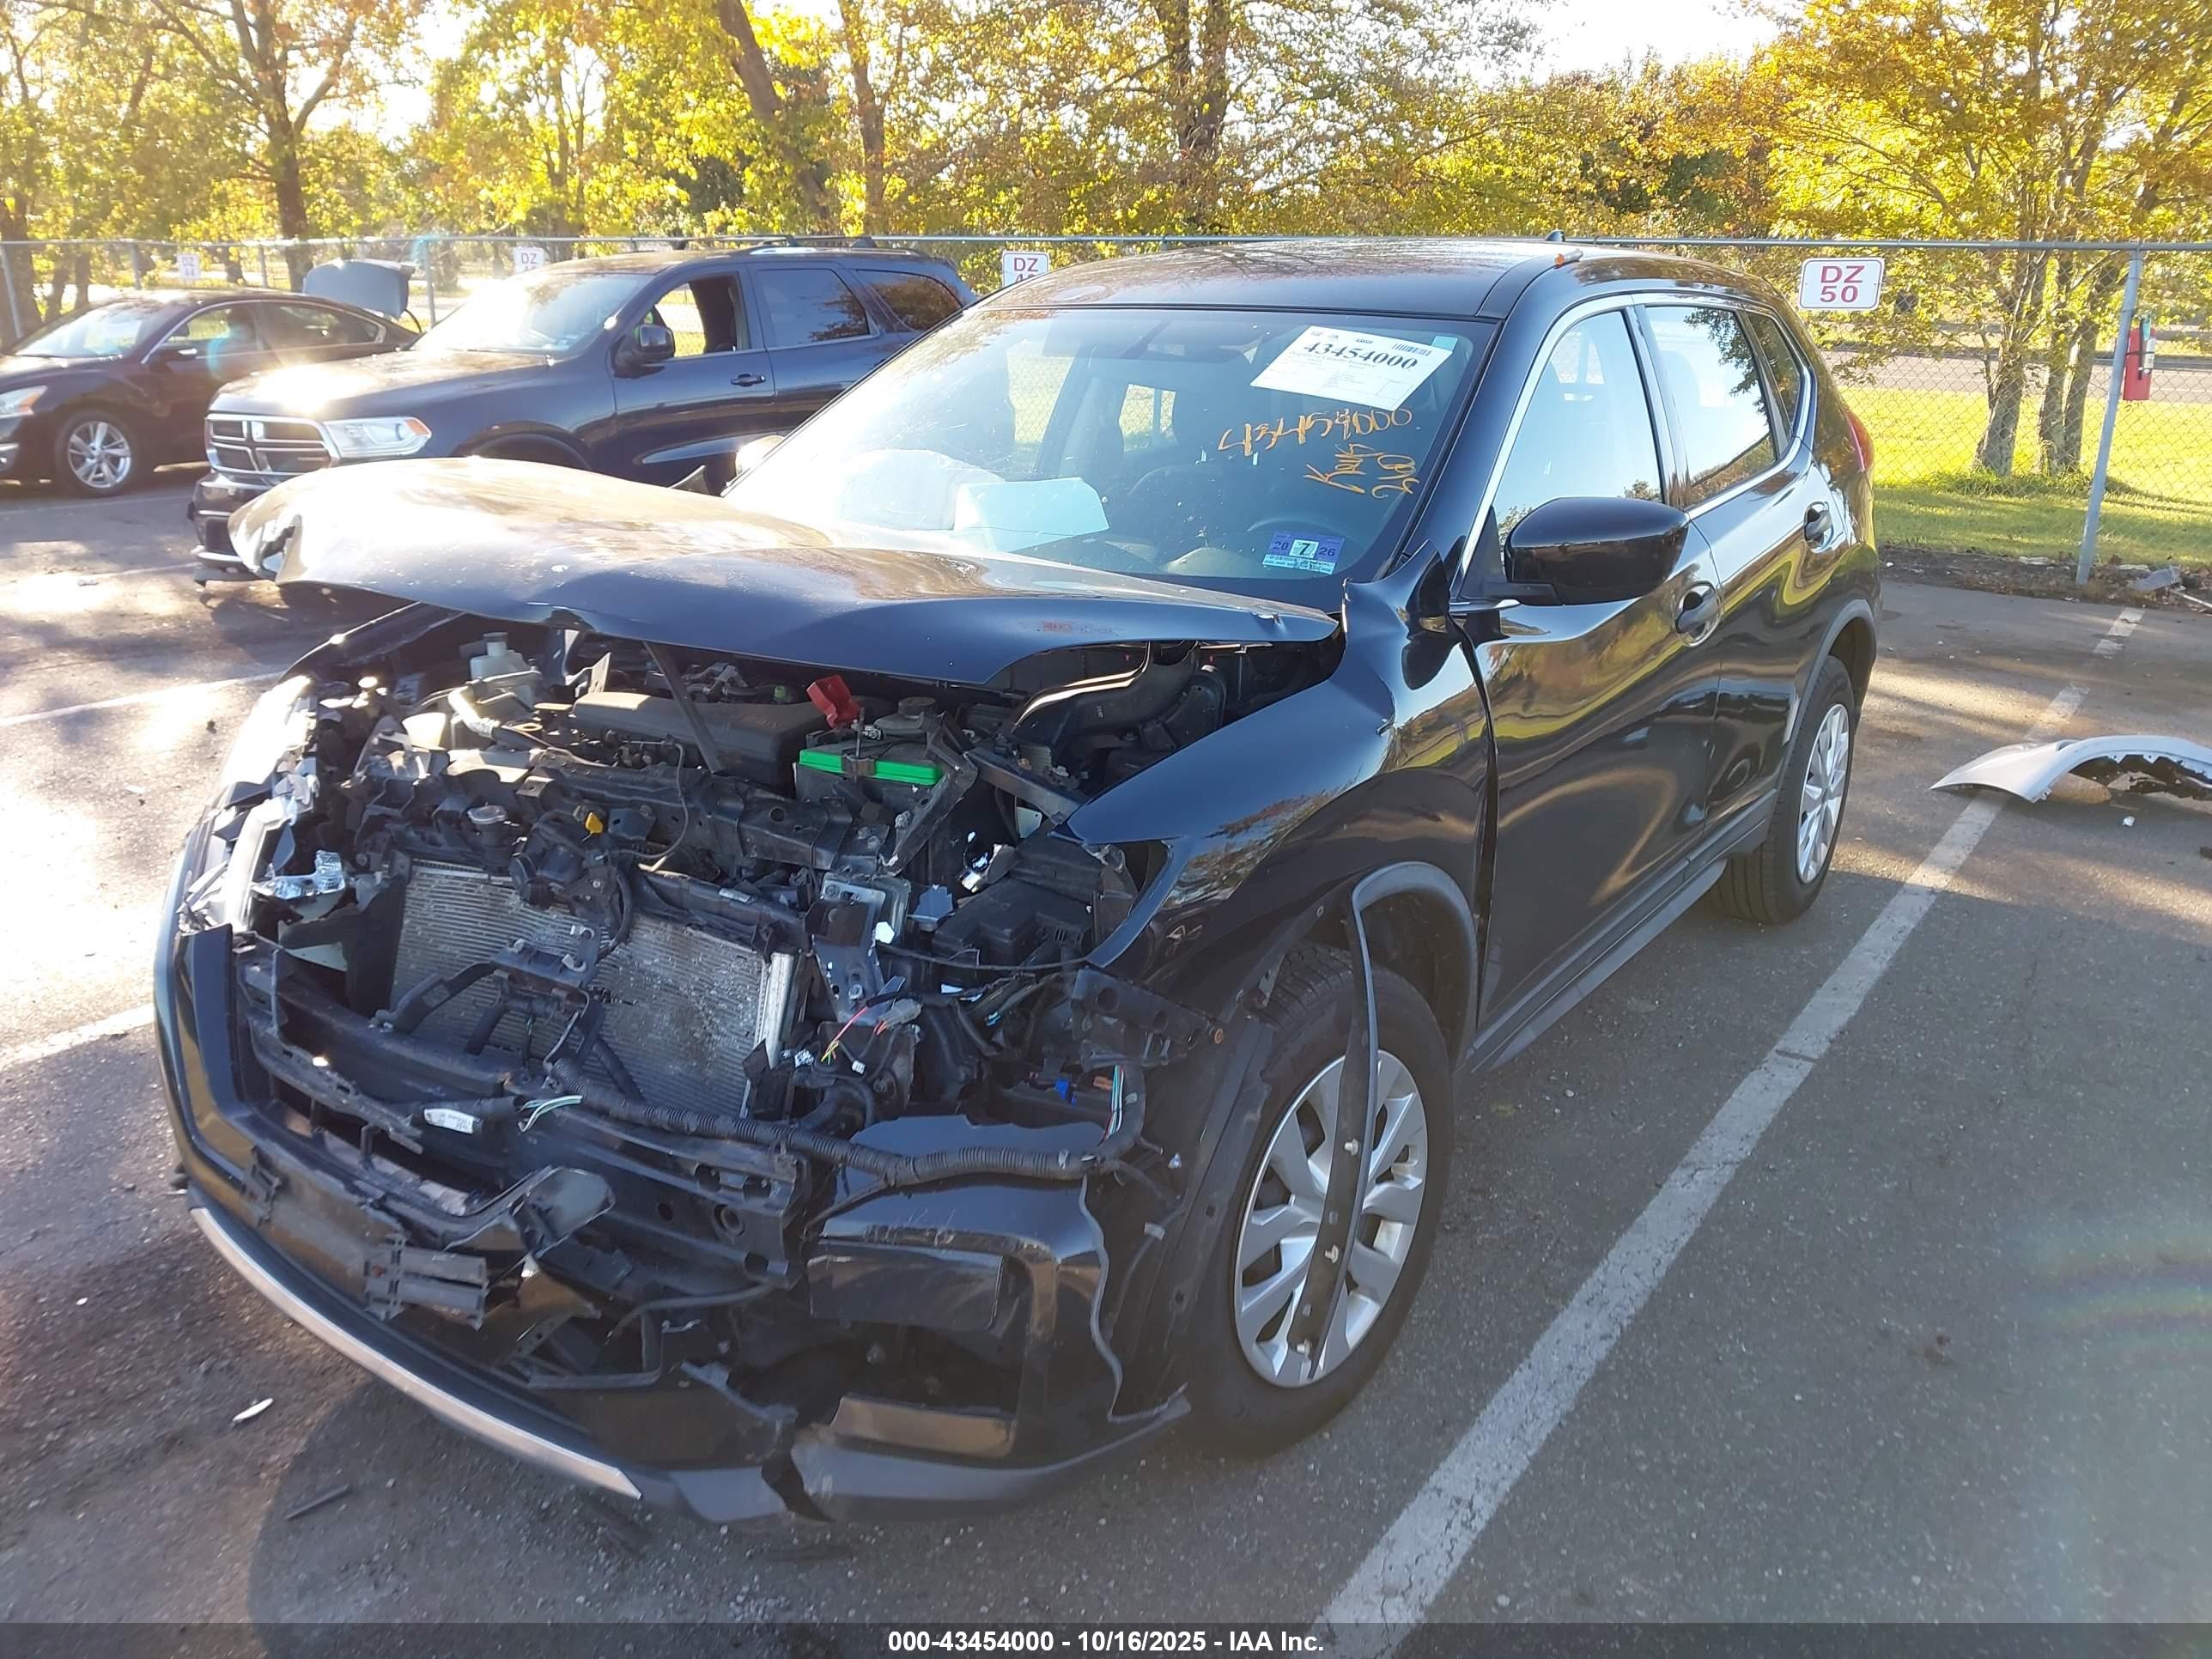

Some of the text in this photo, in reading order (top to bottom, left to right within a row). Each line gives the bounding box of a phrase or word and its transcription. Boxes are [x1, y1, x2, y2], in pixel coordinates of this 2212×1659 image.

[521, 252, 538, 264] DZ
[1014, 258, 1039, 272] DZ
[1820, 265, 1865, 283] DZ
[1820, 285, 1858, 303] 50
[1304, 342, 1419, 370] 43454000
[1273, 541, 1336, 556] 20 7 26
